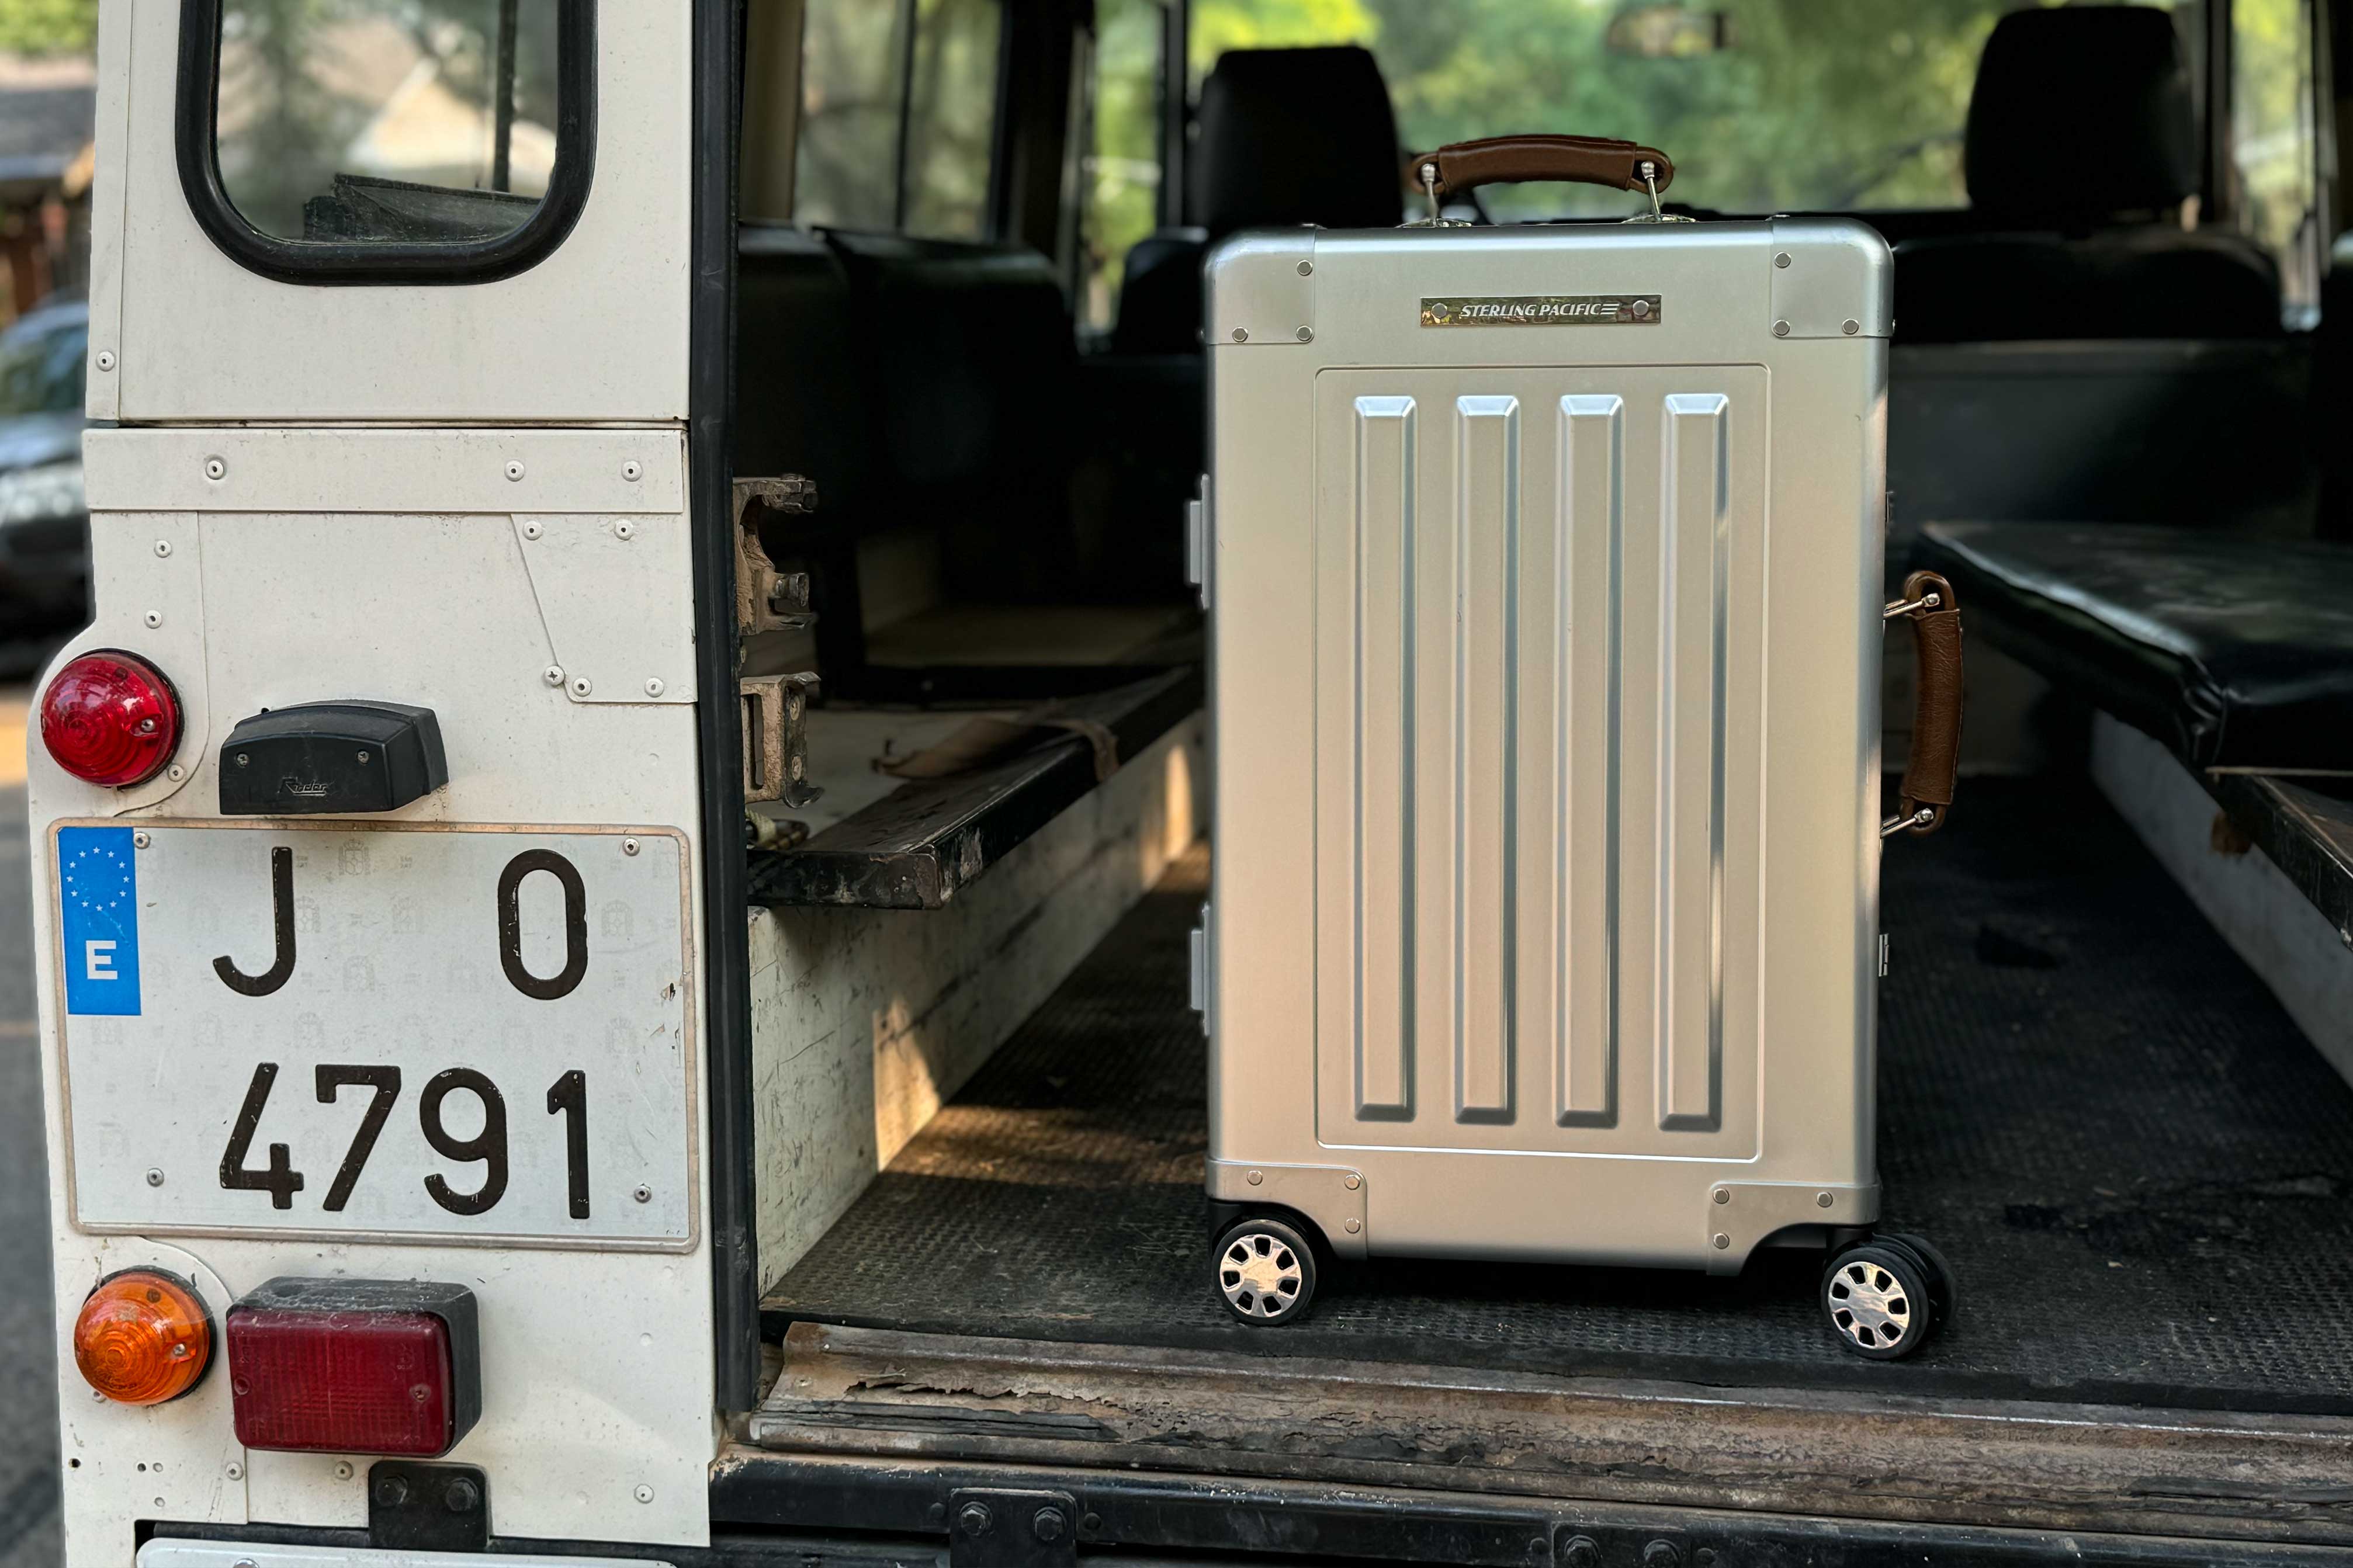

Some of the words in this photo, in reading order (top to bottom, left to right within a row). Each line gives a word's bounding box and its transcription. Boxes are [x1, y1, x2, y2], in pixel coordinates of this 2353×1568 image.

[1458, 304, 1537, 317] STERLING
[1538, 303, 1602, 316] PACIFIC
[86, 940, 118, 980] E
[212, 846, 297, 997] J
[219, 1062, 591, 1220] 4791
